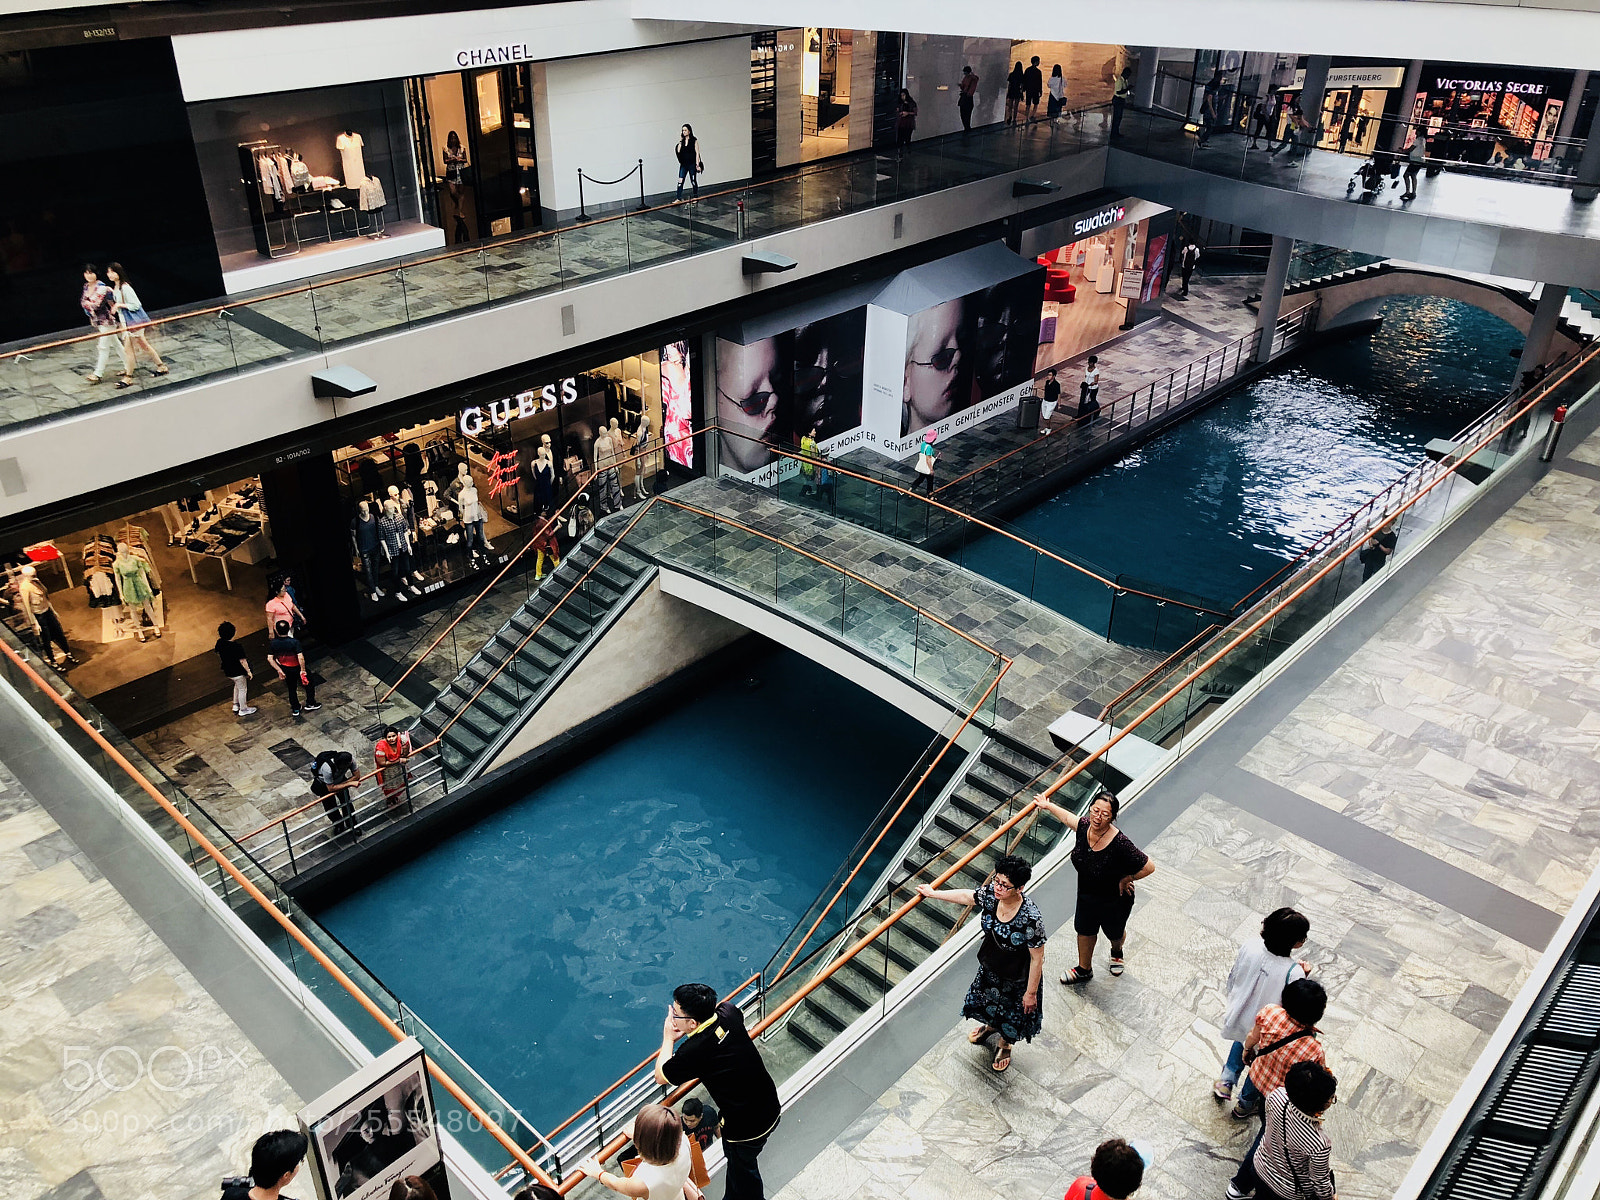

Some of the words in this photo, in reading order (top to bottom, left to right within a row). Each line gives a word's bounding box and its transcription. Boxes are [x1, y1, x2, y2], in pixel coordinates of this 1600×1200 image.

[457, 44, 533, 67] CHANEL
[1329, 74, 1382, 82] FURSTENBERG
[1074, 206, 1119, 236] swatch
[460, 377, 578, 435] GUESS
[883, 439, 913, 453] GENTLE
[915, 423, 950, 446] MOTER
[955, 408, 981, 427] GENTLE
[982, 393, 1015, 415] MONSTER
[837, 431, 876, 449] MONSTER
